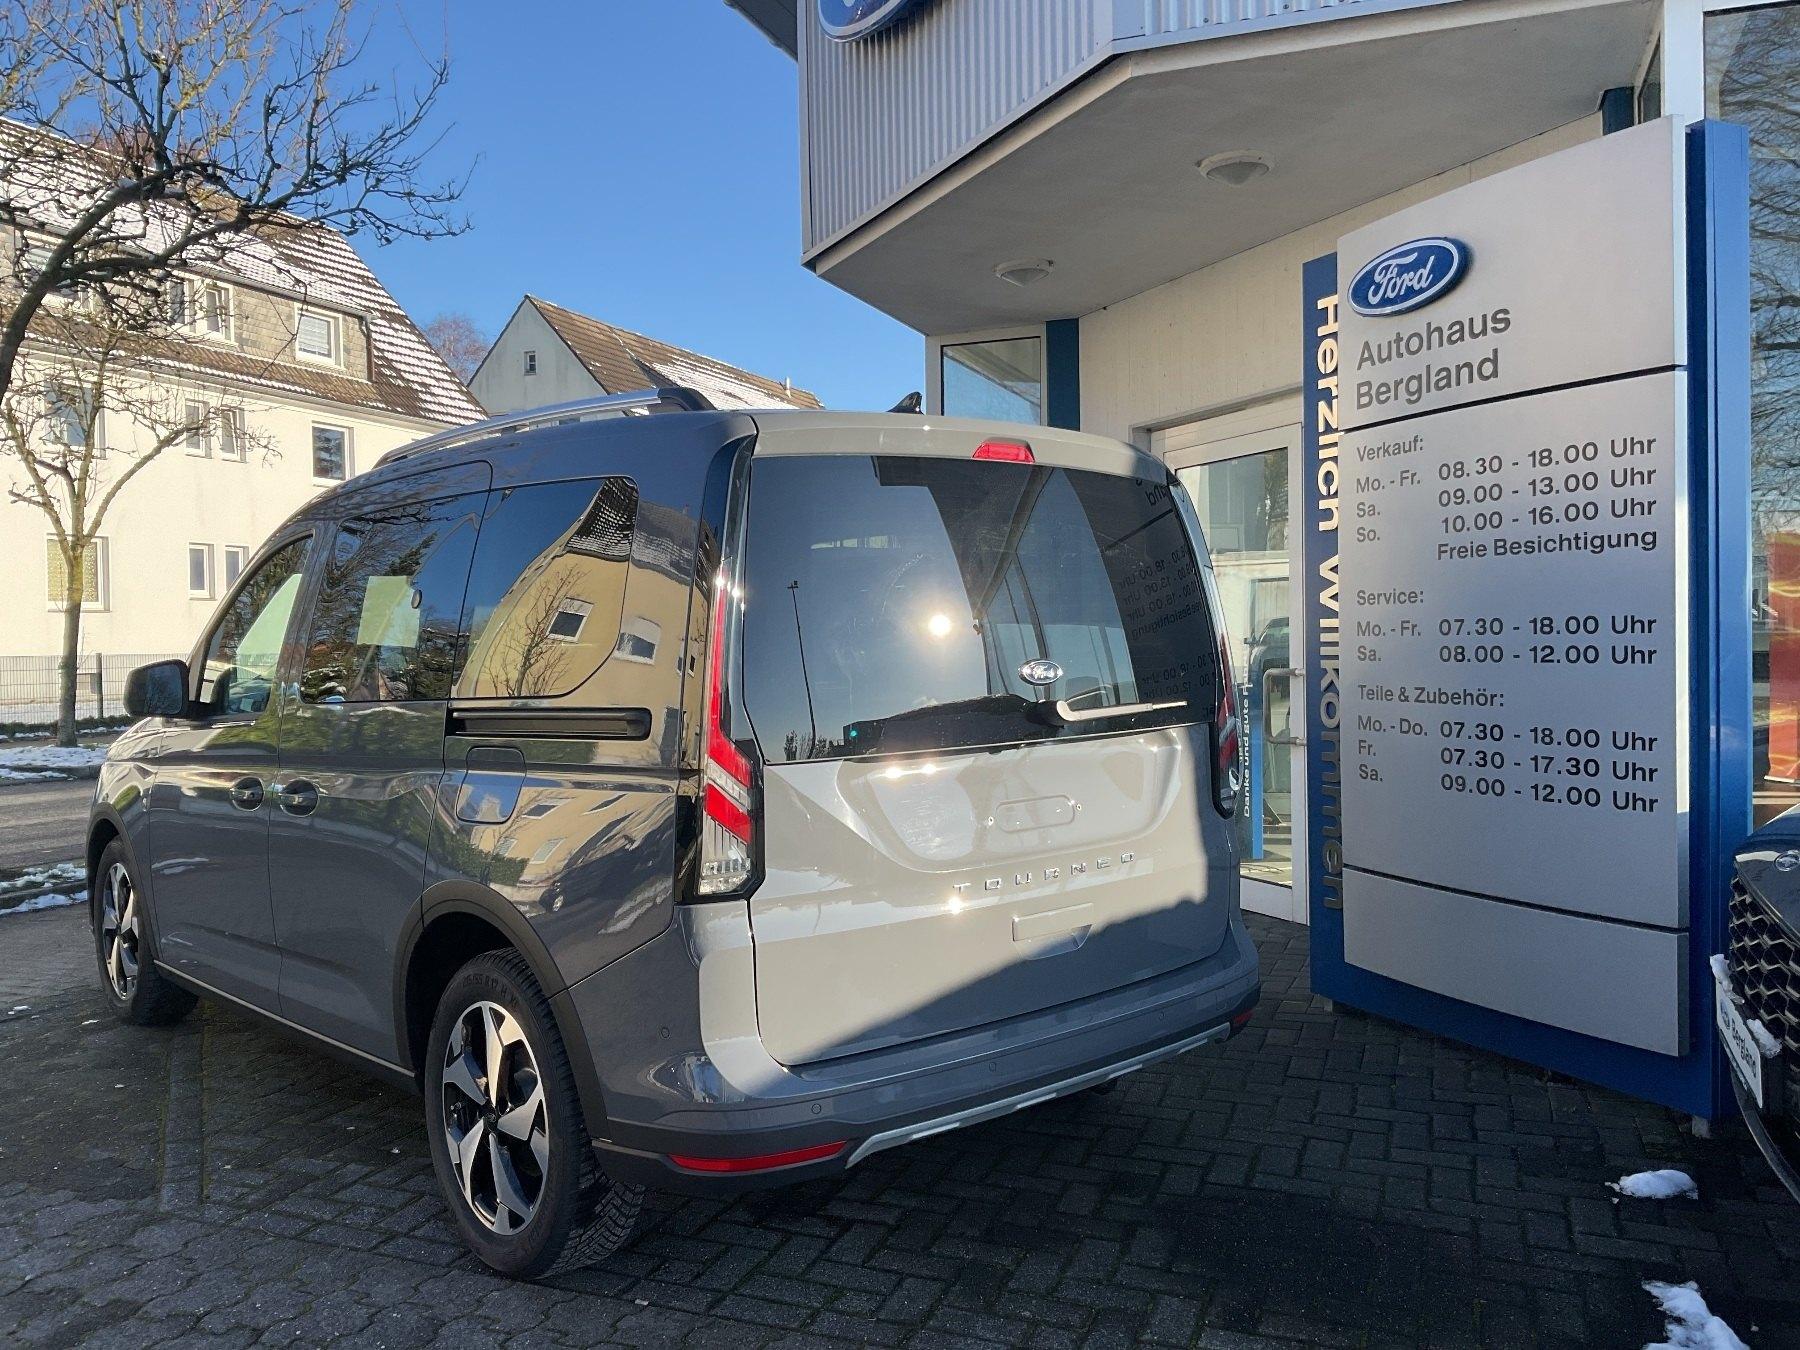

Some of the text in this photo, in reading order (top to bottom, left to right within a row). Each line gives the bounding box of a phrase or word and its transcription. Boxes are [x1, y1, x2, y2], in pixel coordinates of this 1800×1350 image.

[1366, 251, 1436, 306] Ford
[1355, 307, 1511, 372] Autohaus
[1356, 348, 1499, 411] Bergland
[1316, 294, 1339, 531] Herzlich
[1356, 434, 1424, 462] Verkauf:
[1356, 476, 1386, 494] Mo.
[1399, 469, 1421, 487] Fr.
[1438, 455, 1503, 481] 08.30
[1527, 441, 1599, 469] 18.00
[1610, 436, 1657, 458] Uhr
[1356, 501, 1381, 519] Sa.
[1438, 483, 1503, 508] 09.00
[1527, 471, 1599, 497] 13.00
[1610, 466, 1657, 488] Uhr
[1356, 526, 1381, 543] So.
[1441, 510, 1503, 534] 10.00
[1528, 501, 1599, 526] 16.00
[1610, 497, 1657, 519] Uhr
[1437, 531, 1657, 561] Freie Besichtigung
[1356, 588, 1424, 606] Service:
[1356, 620, 1386, 638] Mo.
[1400, 619, 1422, 637] Fr.
[1438, 617, 1504, 636] 07.30
[1528, 615, 1600, 635] 18.00
[1611, 614, 1657, 635] Uhr
[1357, 645, 1382, 662] Sa.
[1439, 645, 1504, 664] 08.00
[1528, 644, 1600, 664] 12.00
[1611, 644, 1658, 665] Uhr
[1357, 684, 1504, 708] Teile & Zubehör:
[1357, 714, 1387, 733] Mo.
[1399, 717, 1428, 737] Do.
[1440, 720, 1504, 742] 07.30
[1529, 726, 1600, 749] 18.00
[1612, 730, 1658, 752] Uhr
[1358, 739, 1377, 757] Fr.
[1440, 747, 1505, 770] 07.30
[1529, 754, 1600, 778] 17.30
[1612, 760, 1659, 783] Uhr
[1358, 763, 1383, 782] Sa.
[1440, 773, 1506, 797] 09.00
[1530, 783, 1601, 808] 12.00
[1612, 790, 1659, 813] Uhr
[952, 852, 1136, 894] TOURNEO
